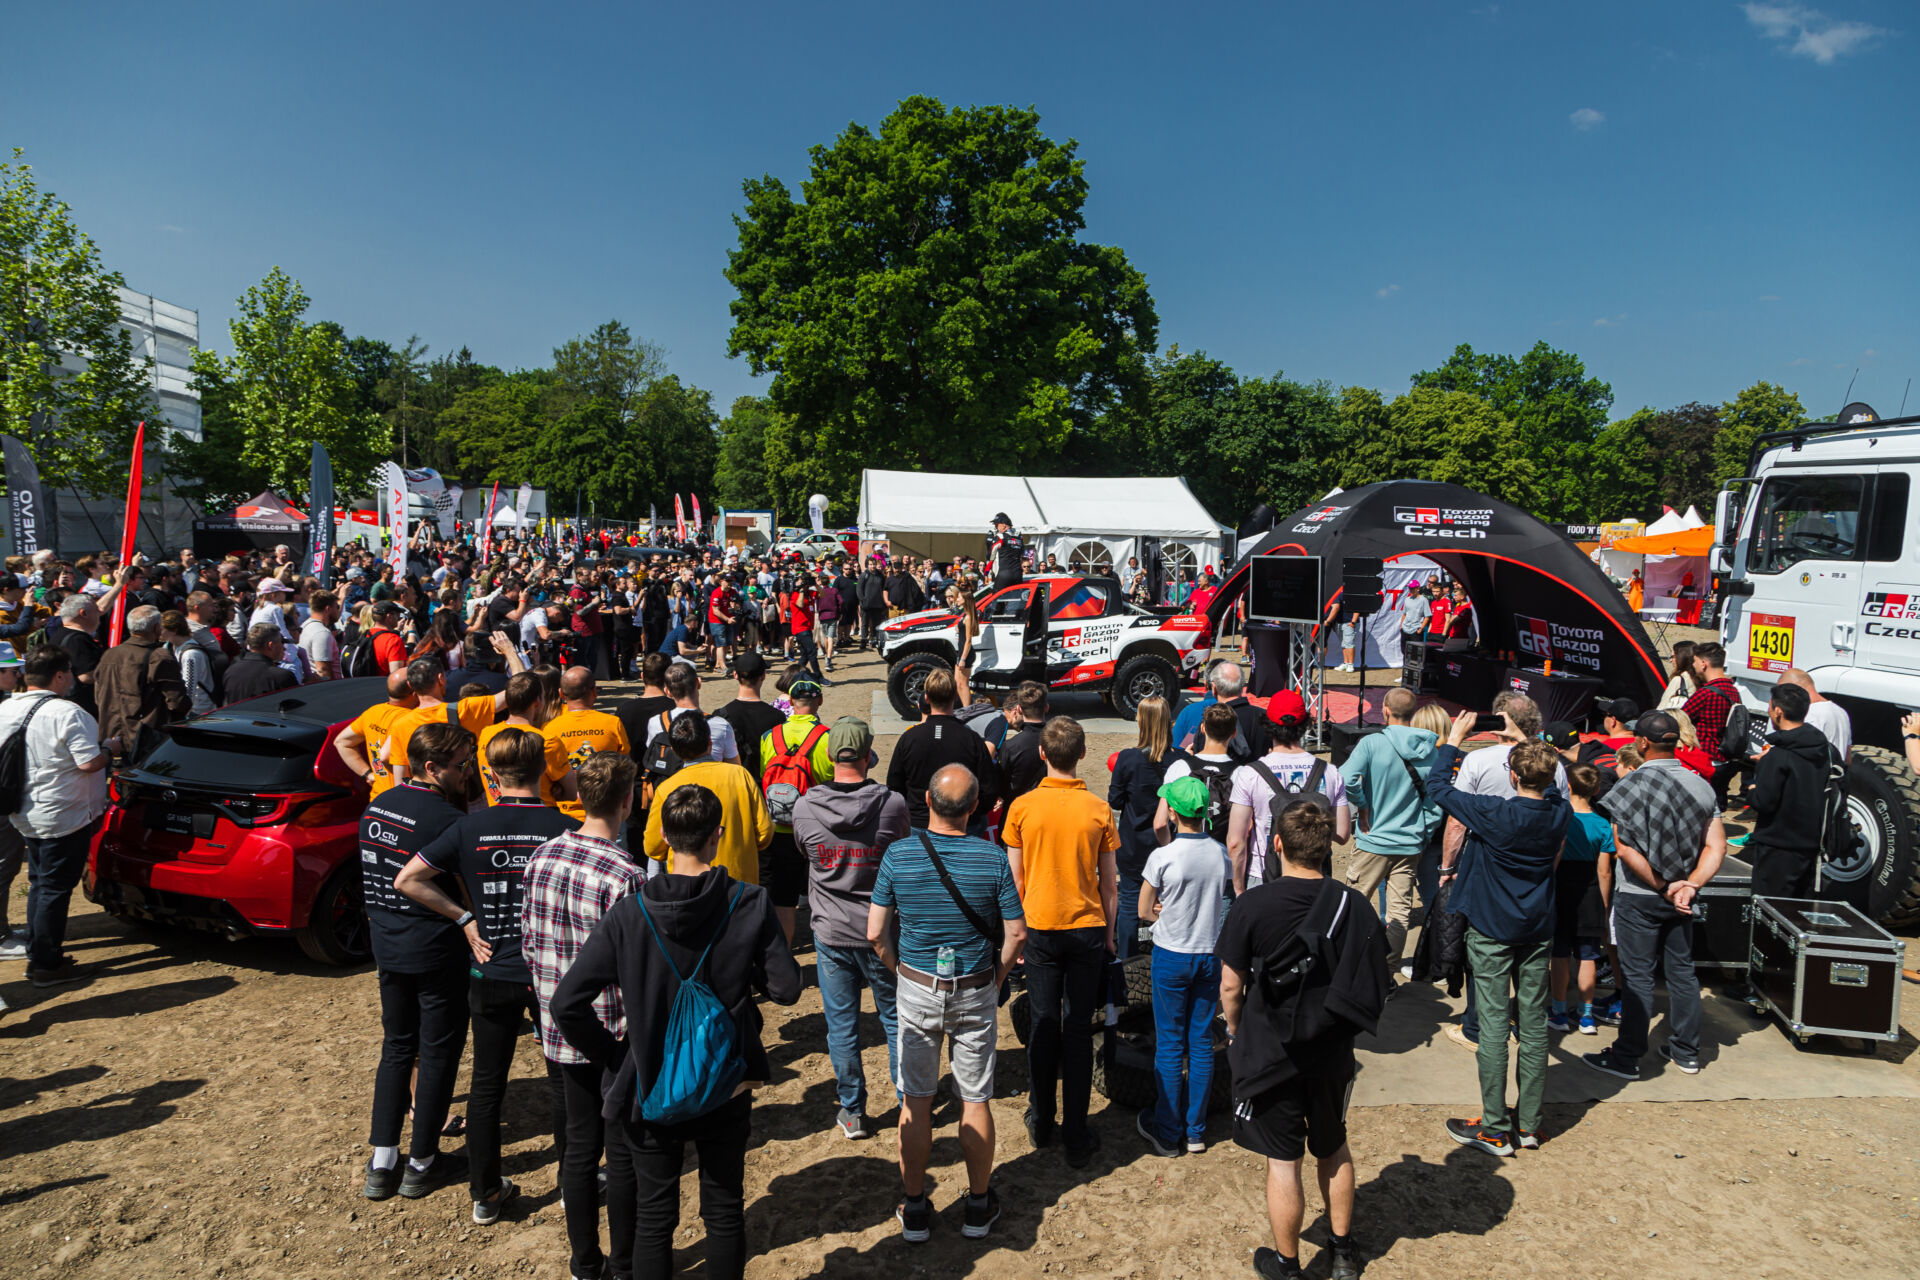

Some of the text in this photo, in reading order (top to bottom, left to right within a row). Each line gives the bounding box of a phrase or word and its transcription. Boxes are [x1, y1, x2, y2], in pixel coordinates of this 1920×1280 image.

[1396, 511, 1439, 524] GR
[1443, 519, 1490, 527] Racing
[1404, 525, 1486, 538] Czech
[1567, 525, 1586, 534] FOOD
[1862, 600, 1905, 618] GR
[1084, 623, 1124, 632] TOYOTA
[1084, 628, 1120, 638] GAZOO
[1549, 623, 1604, 640] TOYOTA
[1083, 635, 1119, 645] Racing
[1519, 630, 1550, 656] GR
[1552, 637, 1600, 654] GAZOO
[1752, 629, 1790, 657] 1430
[1061, 646, 1109, 660] Czech
[1554, 648, 1600, 671] Racing
[561, 729, 604, 738] AUTOKROS
[382, 831, 399, 841] CTU
